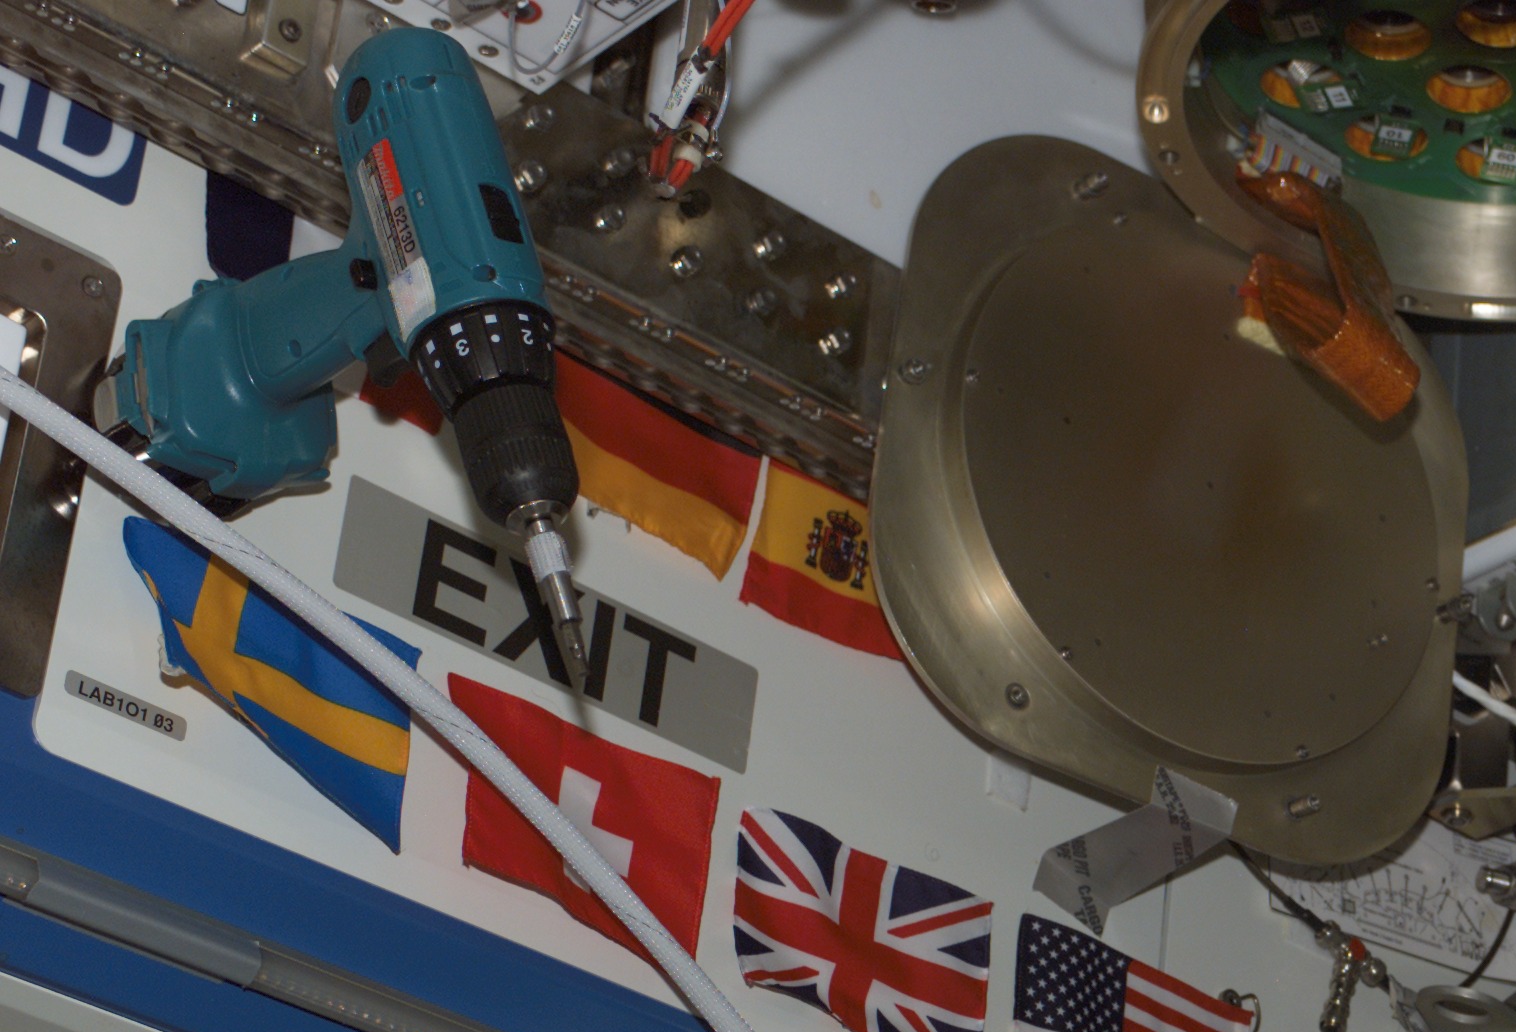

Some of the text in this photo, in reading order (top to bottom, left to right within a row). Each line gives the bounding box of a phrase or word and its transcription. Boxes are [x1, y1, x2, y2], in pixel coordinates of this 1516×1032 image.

[391, 205, 417, 254] 6213D
[456, 338, 469, 356] 3
[521, 329, 534, 345] 2
[413, 518, 697, 728] EXIT
[1077, 884, 1104, 934] CARGO
